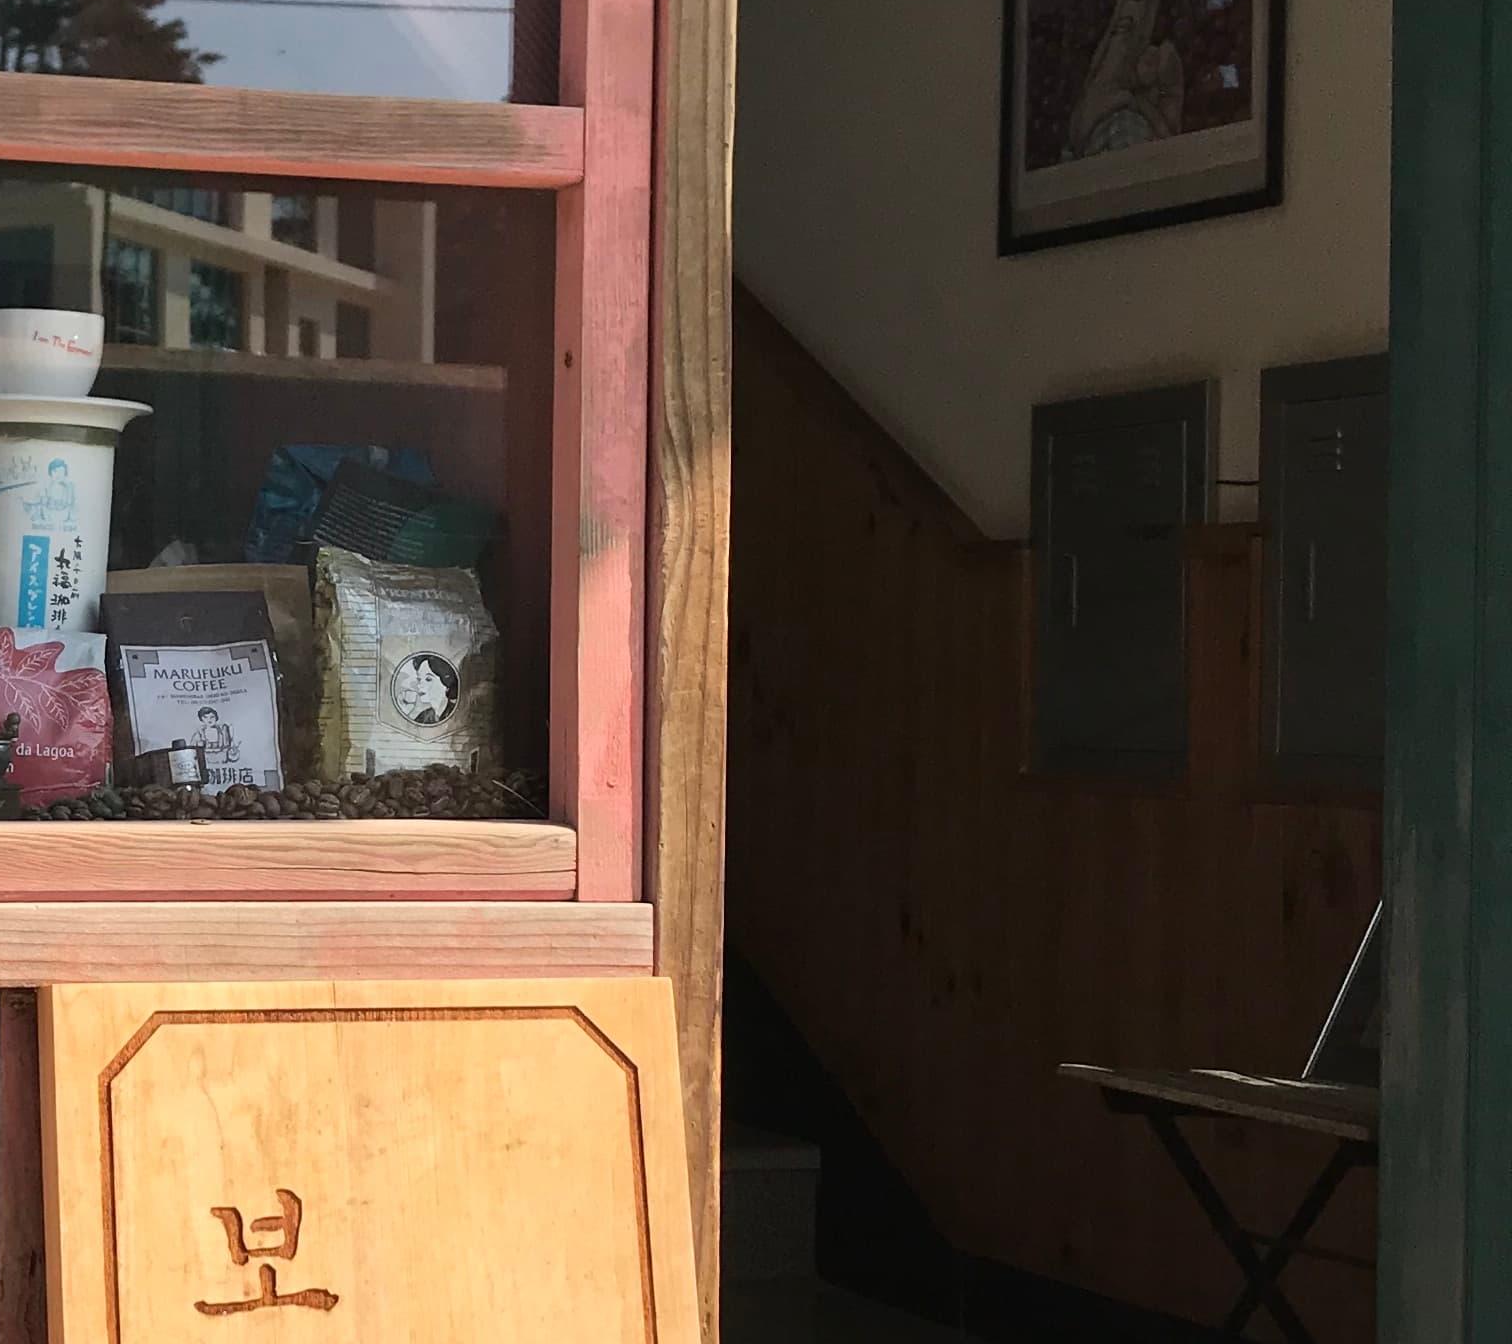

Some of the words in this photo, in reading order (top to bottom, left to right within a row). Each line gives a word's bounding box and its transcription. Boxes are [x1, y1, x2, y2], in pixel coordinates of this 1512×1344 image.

[154, 663, 243, 680] MARUFUKU
[173, 678, 228, 692] COFFEE
[16, 743, 32, 756] da
[36, 743, 75, 761] Lagoa
